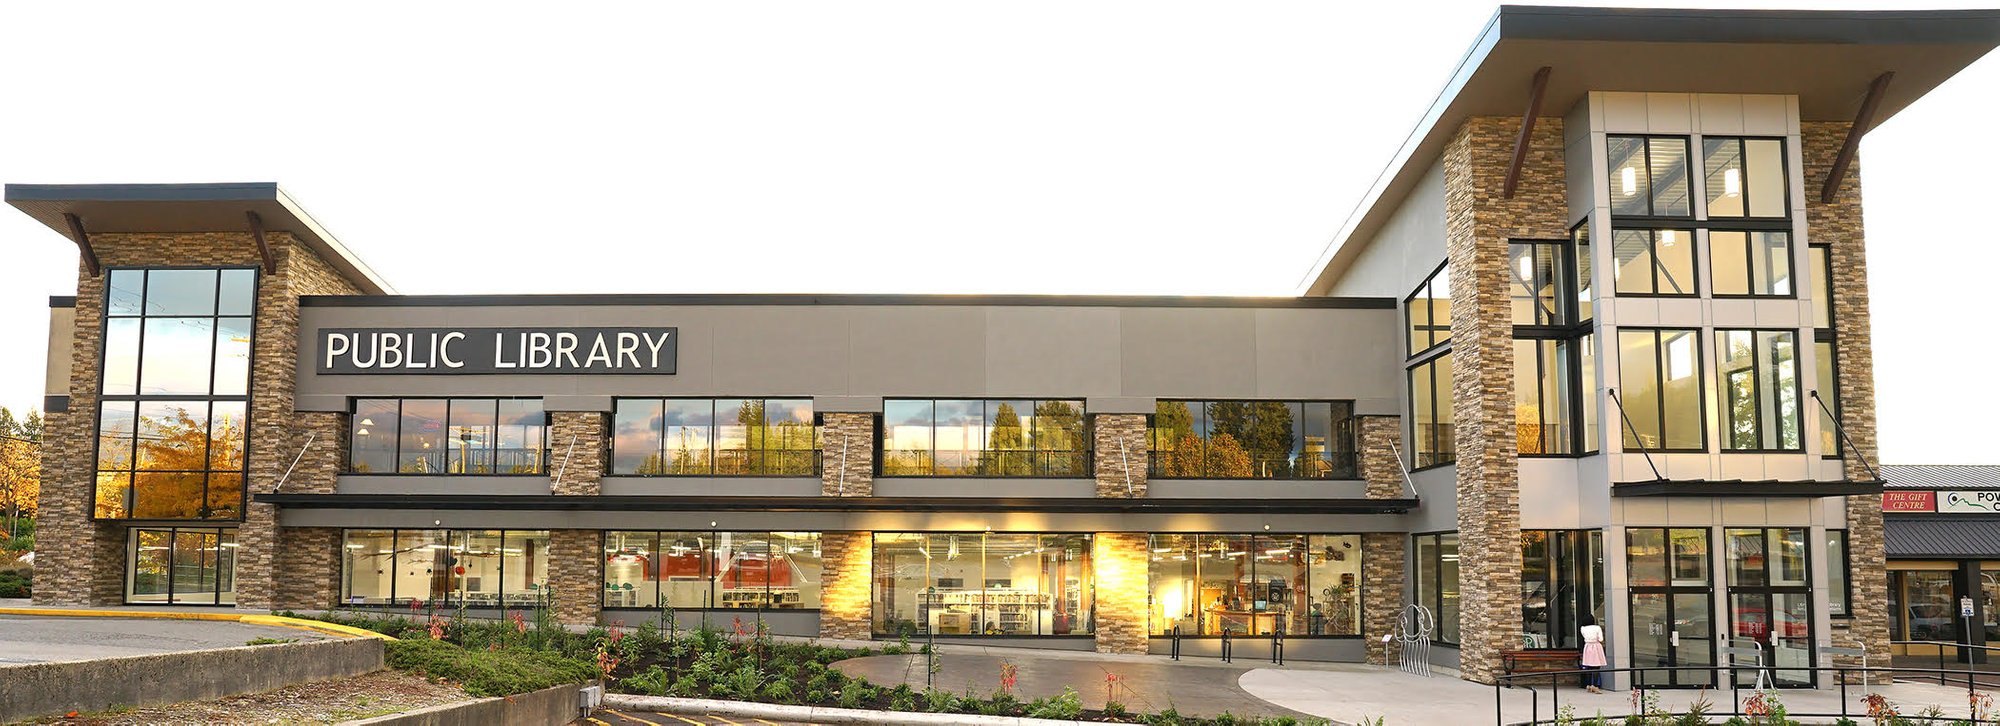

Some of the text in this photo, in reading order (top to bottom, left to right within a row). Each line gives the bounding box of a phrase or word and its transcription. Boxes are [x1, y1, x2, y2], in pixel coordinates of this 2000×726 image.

[326, 332, 670, 369] PUBLIC LIBRARY
[1889, 493, 1927, 501] THE GIFT
[1892, 501, 1926, 509] CENTRE
